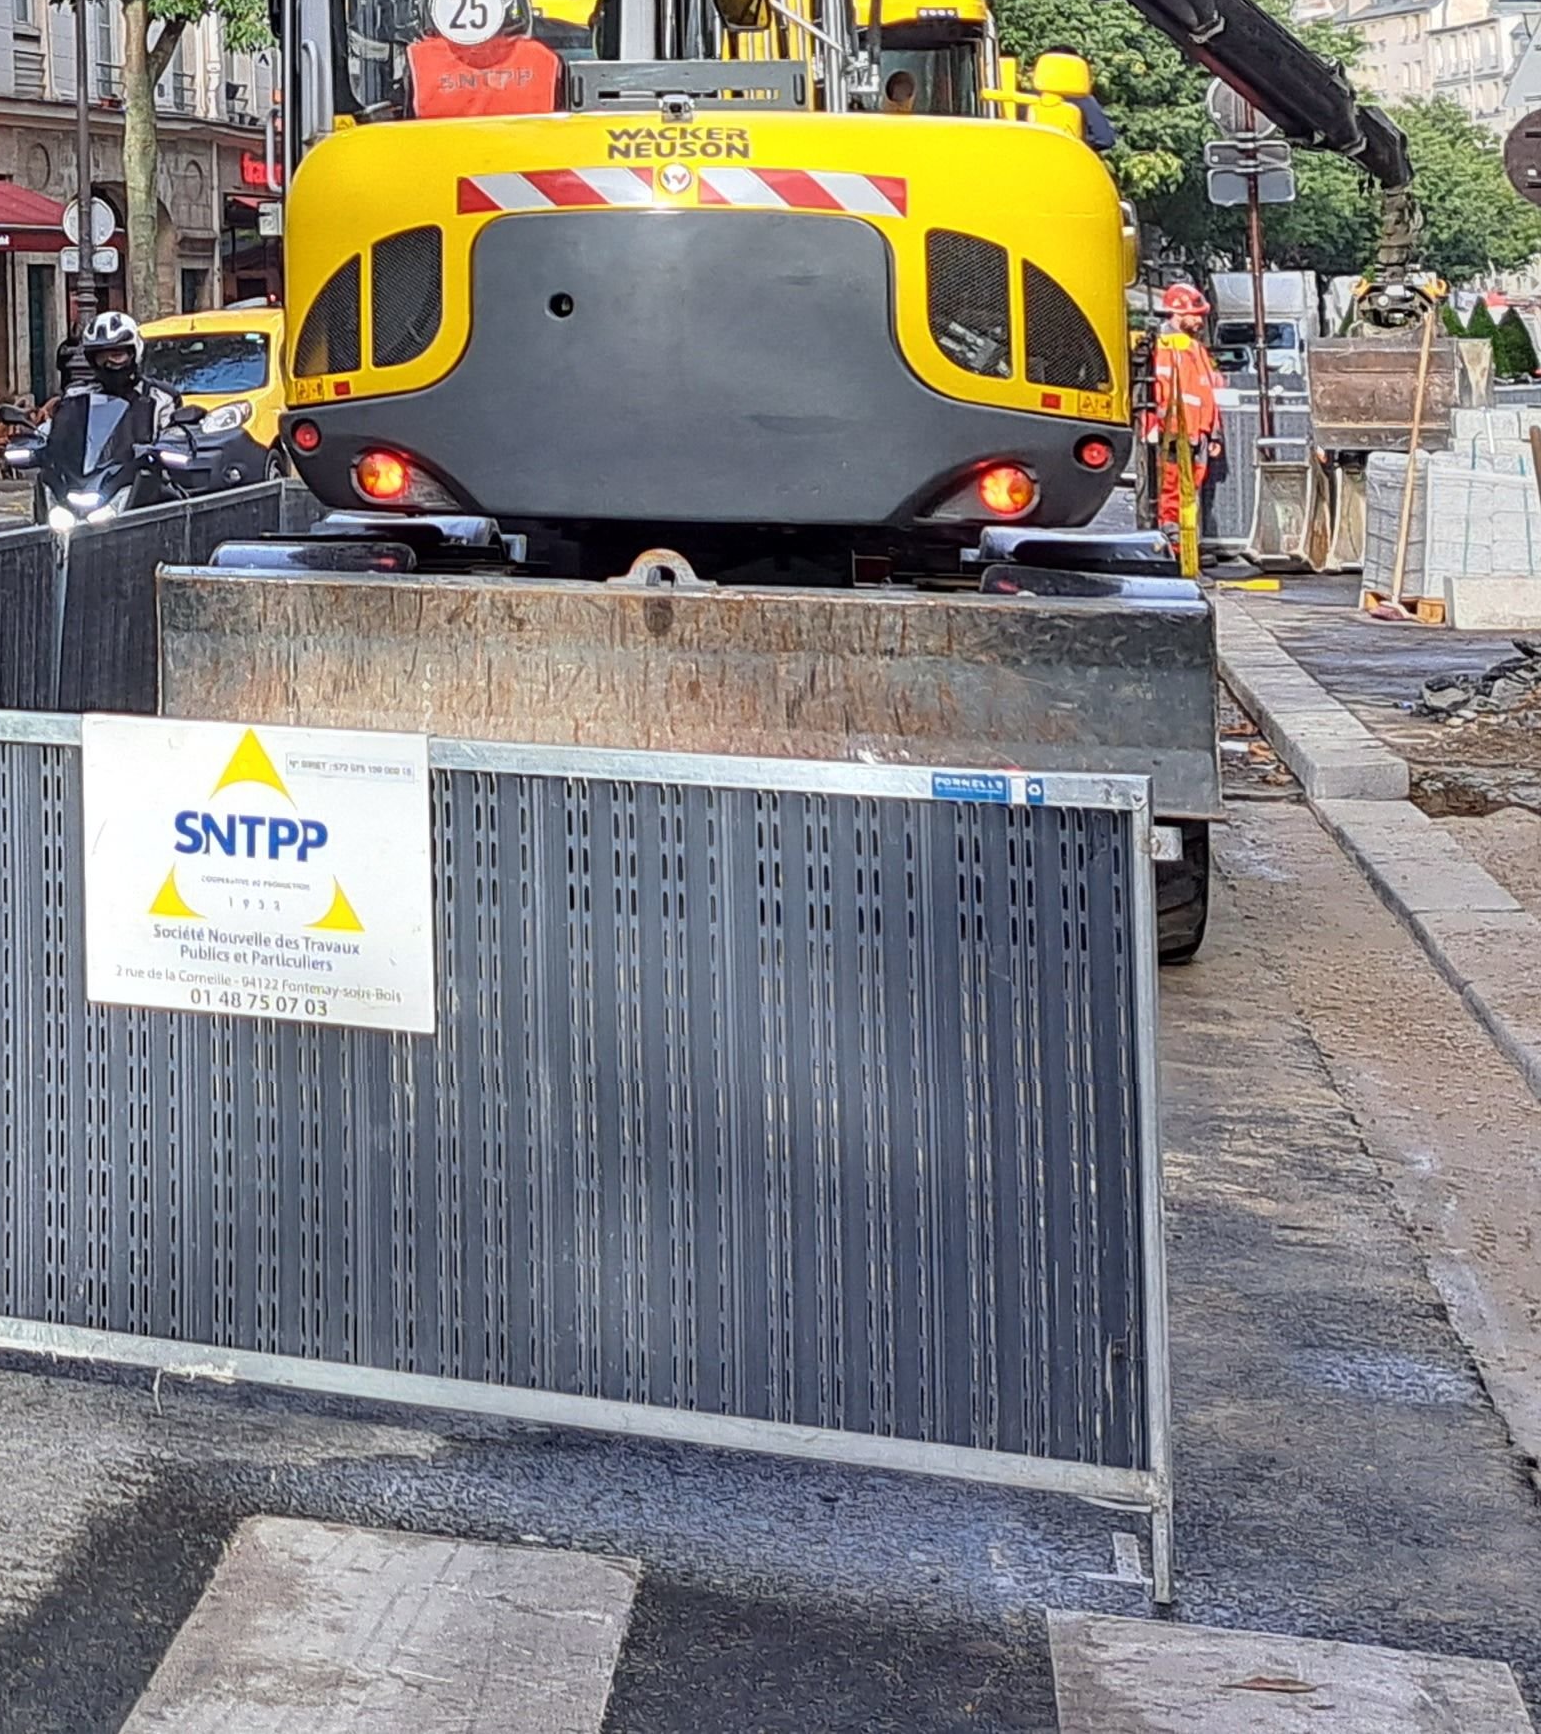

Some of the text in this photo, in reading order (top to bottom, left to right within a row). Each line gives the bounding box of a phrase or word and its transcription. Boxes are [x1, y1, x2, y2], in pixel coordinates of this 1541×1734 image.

[437, 69, 535, 92] SNTPP
[605, 126, 750, 142] WACKER
[606, 141, 750, 160] NEUSON
[173, 809, 328, 862] SNTPP
[153, 923, 360, 956] Société Nouvelle des Travaux
[180, 944, 334, 973] Publics et Particuliers
[116, 964, 123, 977] 2
[125, 967, 145, 978] rue
[147, 967, 163, 980] de
[165, 968, 176, 982] la
[178, 969, 232, 987] Corneille
[190, 987, 328, 1017] 01 48 75 07 03
